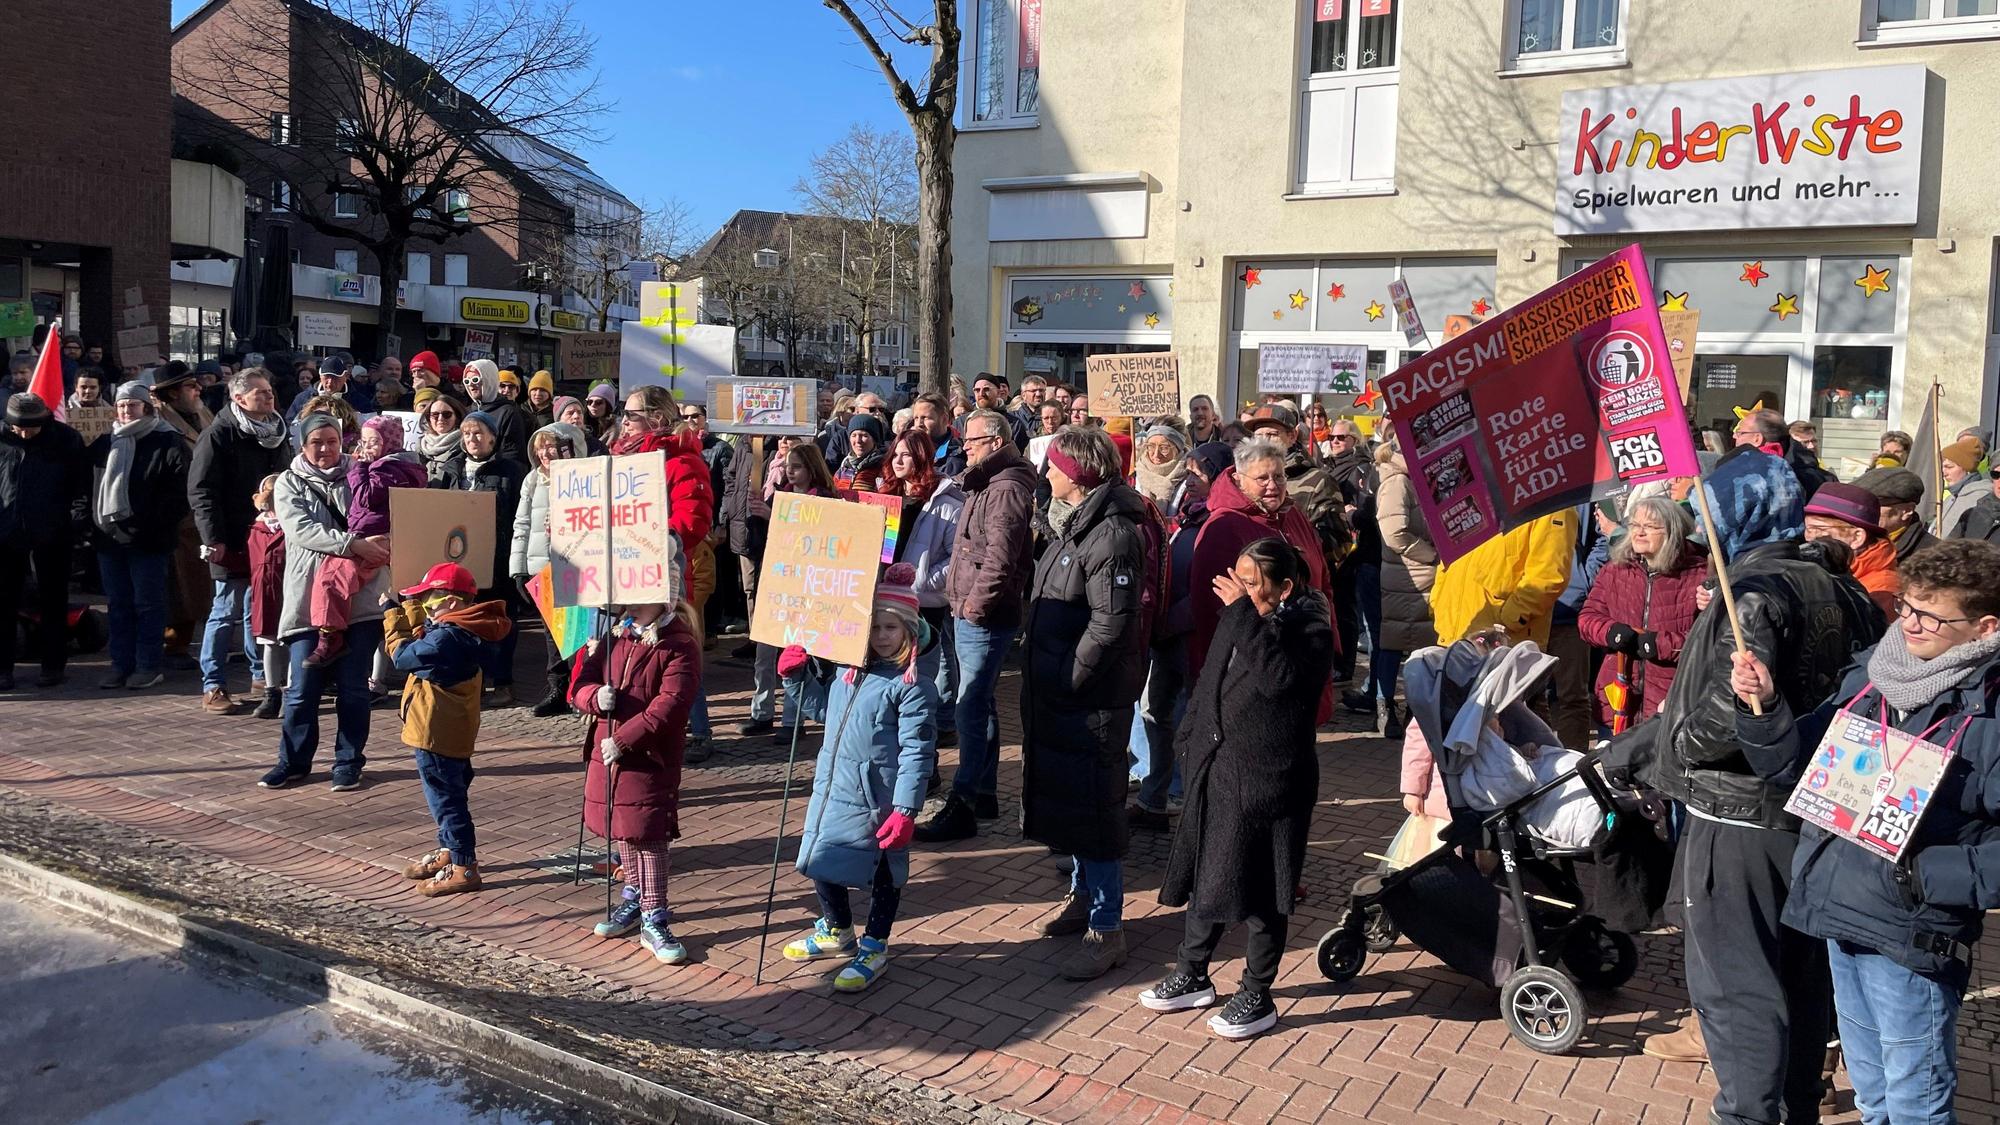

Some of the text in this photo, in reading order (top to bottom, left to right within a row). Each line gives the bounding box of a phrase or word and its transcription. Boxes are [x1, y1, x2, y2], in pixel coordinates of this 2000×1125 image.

[1572, 173, 1900, 214] Spielwaren und mehr...
[342, 278, 359, 289] dm
[467, 301, 525, 319] Mamma Mia
[1507, 265, 1630, 342] RASSISTISCHER
[1512, 285, 1637, 360] SCHEISSVEREIN
[1087, 357, 1171, 373] WIR NEHMEN
[1111, 370, 1175, 384] EINFACH DIE
[1387, 330, 1507, 411] RACISM!
[1120, 393, 1166, 407] SCHIEBEN
[1139, 383, 1164, 394] UND
[1599, 390, 1626, 407] KEIN
[1627, 388, 1661, 405] NAZIS
[745, 400, 780, 409] BUNT!
[1119, 404, 1166, 415] WOANDERS
[1429, 394, 1465, 421] STABIL
[1432, 402, 1471, 431] BLEIBEN
[1487, 395, 1546, 436] Rote
[1495, 412, 1567, 460] Karte
[1609, 432, 1660, 458] FCK
[1503, 433, 1587, 484] für die
[1618, 449, 1664, 473] AFD
[614, 466, 650, 500] DIE
[1513, 462, 1568, 506] AfD!
[564, 499, 654, 532] FREIHEIT
[777, 499, 823, 527] WENN
[1441, 500, 1468, 521] KEIN
[1447, 507, 1476, 530] BOCK
[617, 563, 662, 589] UNS!
[771, 561, 866, 597] MEHR RECHTE
[768, 592, 814, 610] FORDERN
[1799, 788, 1837, 813] Rote Karte
[1806, 803, 1819, 815] die
[1870, 801, 1914, 832] FCK
[1862, 816, 1906, 846] AFD
[1501, 848, 1517, 873] Joie
